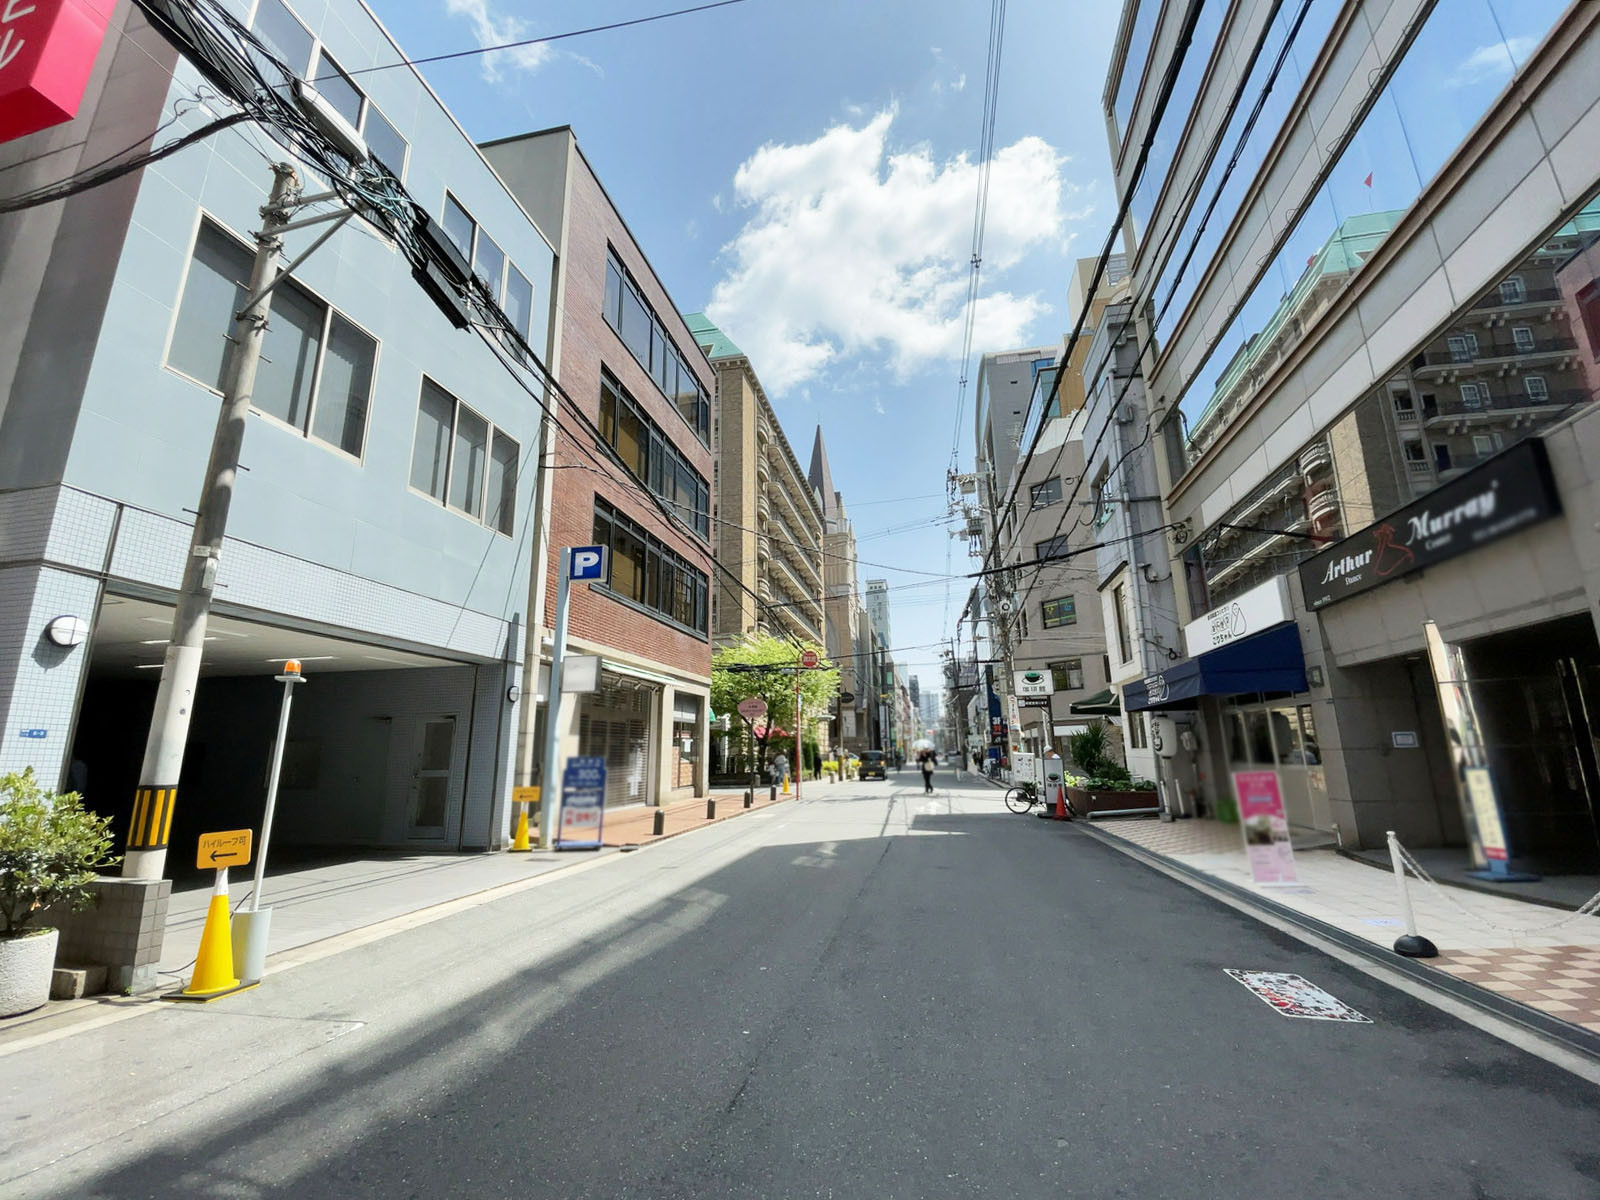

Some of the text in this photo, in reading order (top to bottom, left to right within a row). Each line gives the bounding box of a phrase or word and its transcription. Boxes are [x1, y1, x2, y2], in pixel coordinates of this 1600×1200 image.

[1321, 549, 1373, 585] Arthur
[1405, 491, 1495, 546] Murray
[574, 552, 599, 576] P
[203, 836, 246, 848] ハイルーフ可
